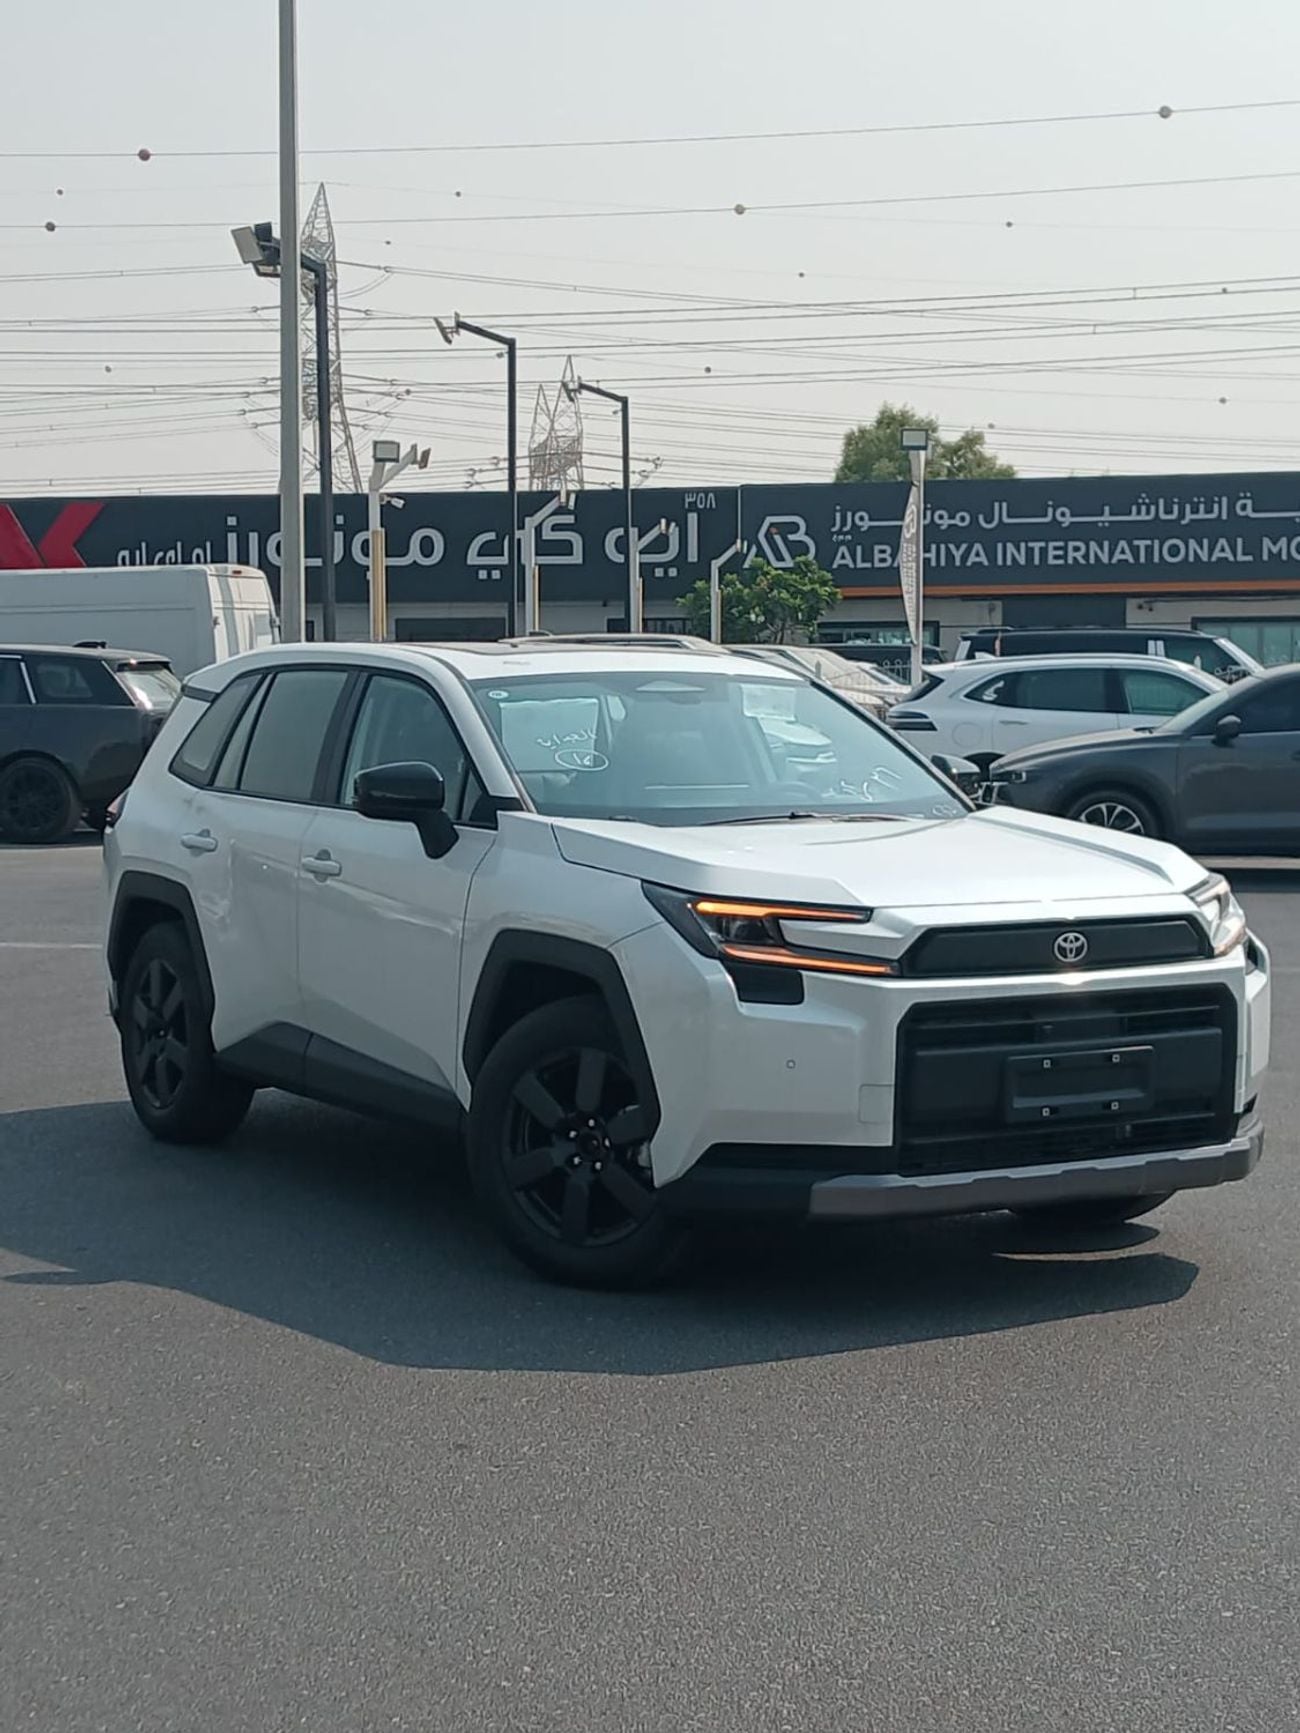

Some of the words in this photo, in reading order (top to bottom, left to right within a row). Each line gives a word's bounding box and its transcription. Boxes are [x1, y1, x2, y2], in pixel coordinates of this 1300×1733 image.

[685, 492, 716, 509] ٣٥٨
[977, 493, 1228, 529] انترناشيونال
[832, 542, 989, 569] ALBHIYA
[996, 537, 1253, 566] INTERNATIONAL
